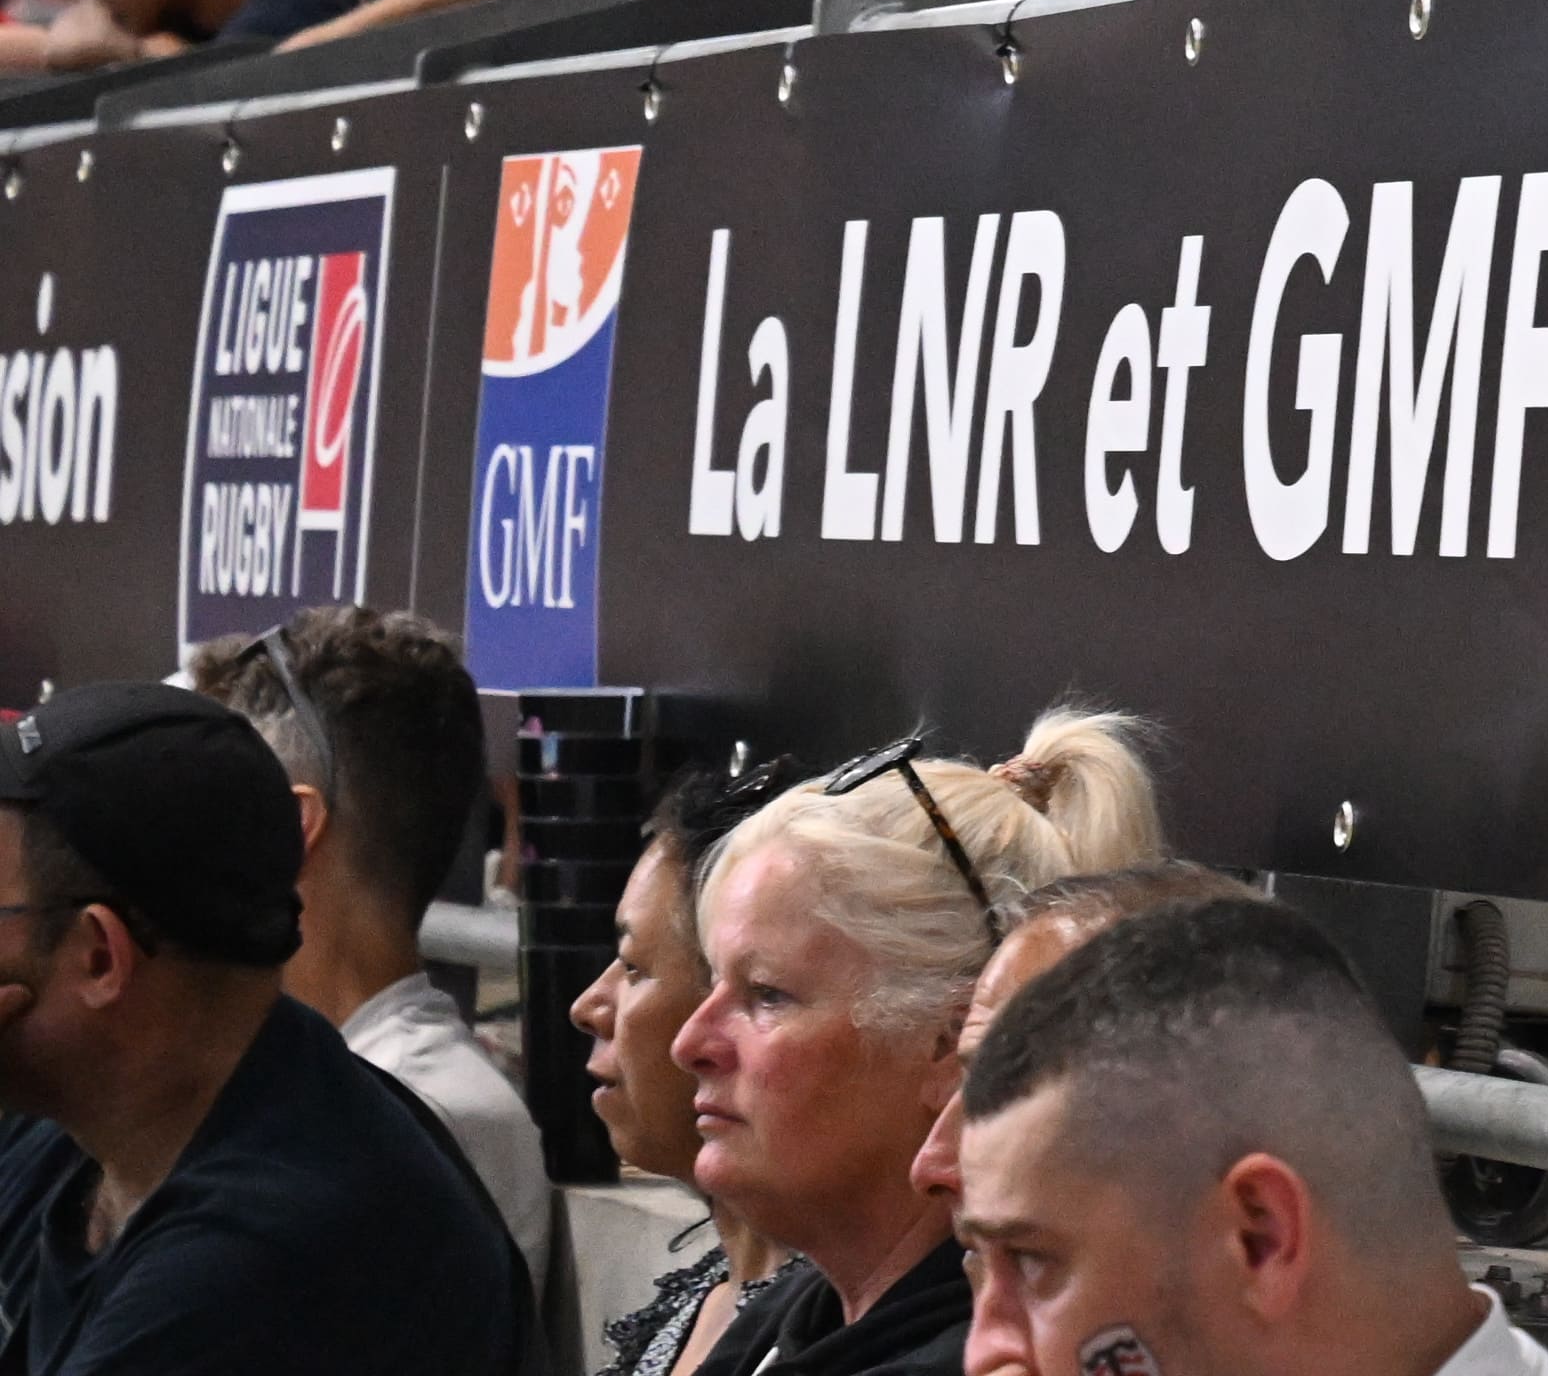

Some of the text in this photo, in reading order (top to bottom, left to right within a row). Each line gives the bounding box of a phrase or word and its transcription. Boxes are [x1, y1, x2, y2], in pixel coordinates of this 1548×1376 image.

[215, 255, 313, 376] LIGUE
[688, 228, 790, 543] La
[820, 213, 1067, 546] LNR
[1084, 234, 1212, 555] et
[0, 270, 118, 525] sion
[207, 394, 299, 458] NATIONALE
[199, 482, 293, 598] RUGBY
[479, 443, 596, 610] GMF
